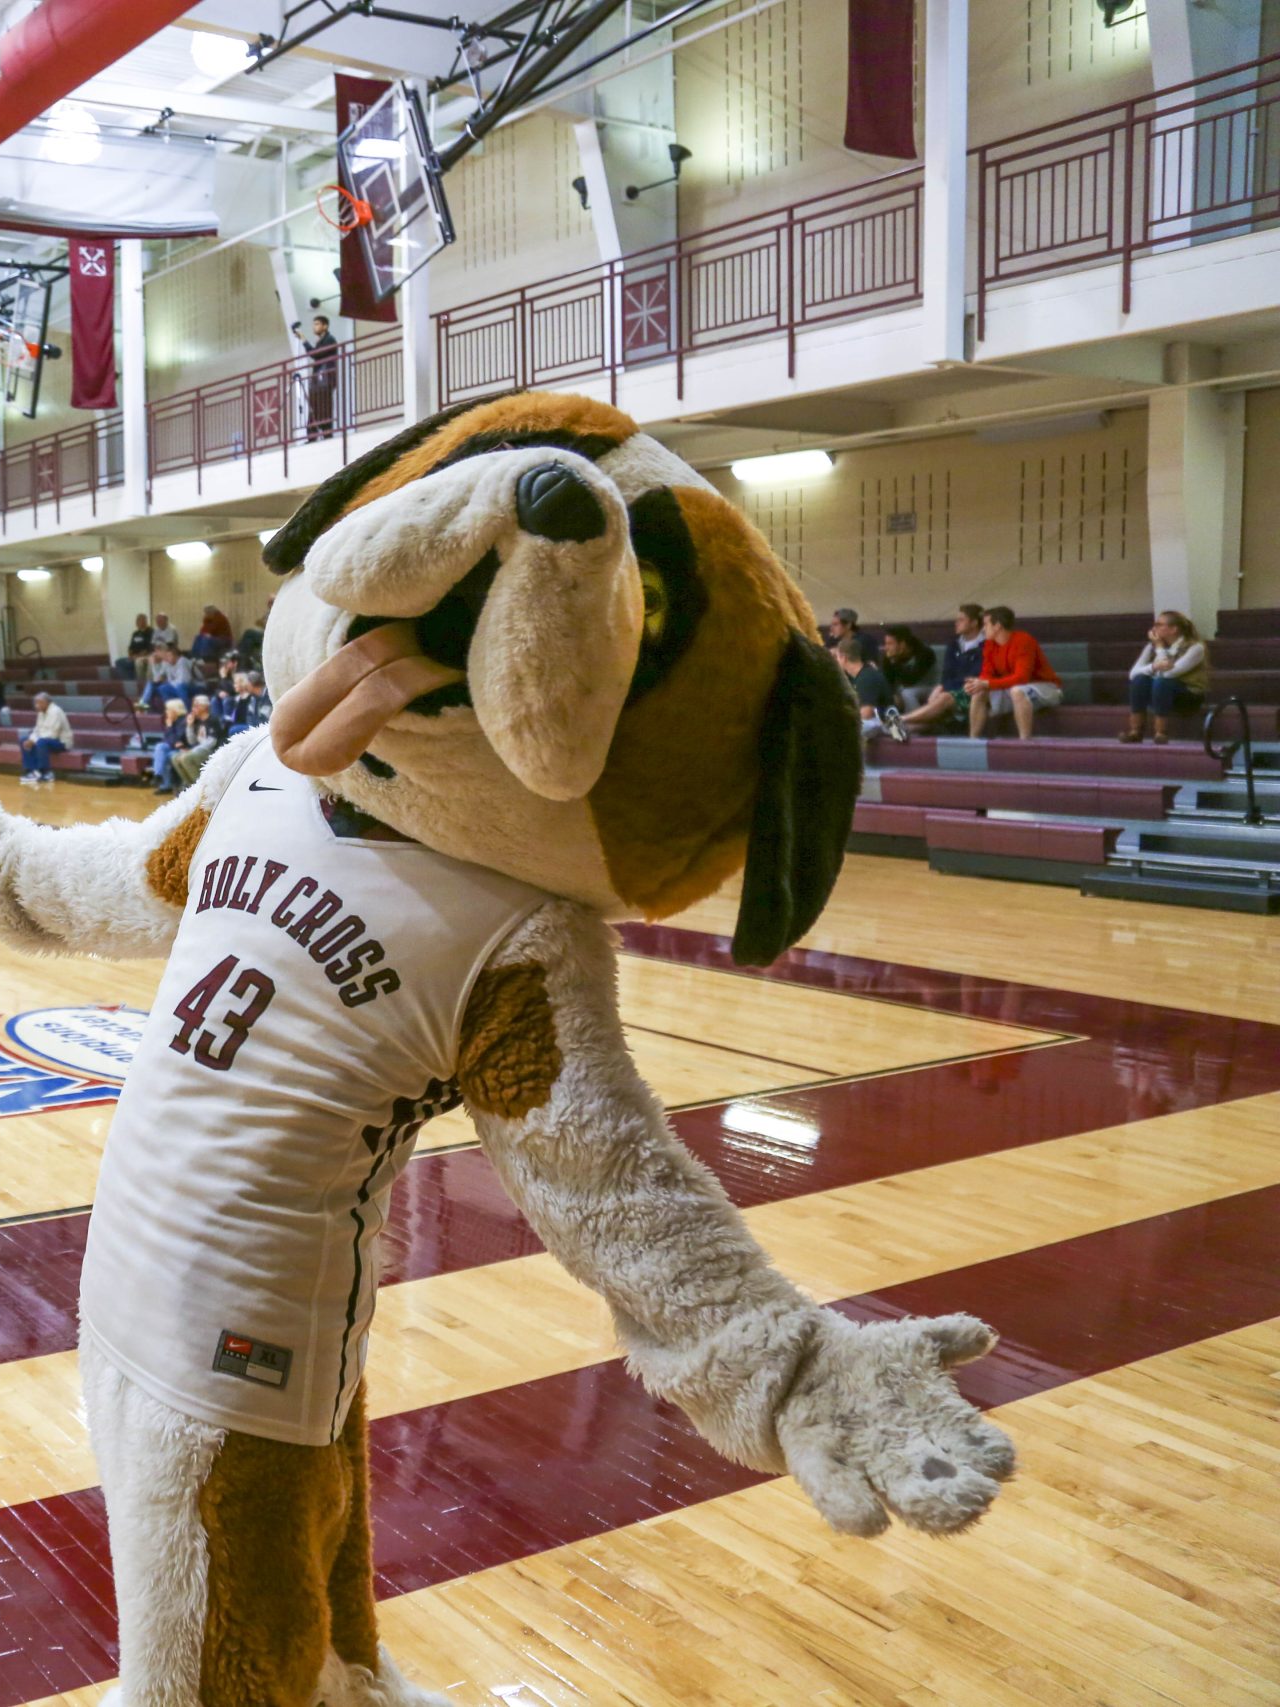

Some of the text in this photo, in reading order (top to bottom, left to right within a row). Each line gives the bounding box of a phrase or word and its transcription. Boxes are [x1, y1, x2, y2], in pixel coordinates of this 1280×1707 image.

[195, 855, 402, 1009] HOLY CROSS
[34, 1022, 134, 1063] ampions
[70, 1014, 143, 1043] acter
[169, 954, 276, 1070] 43
